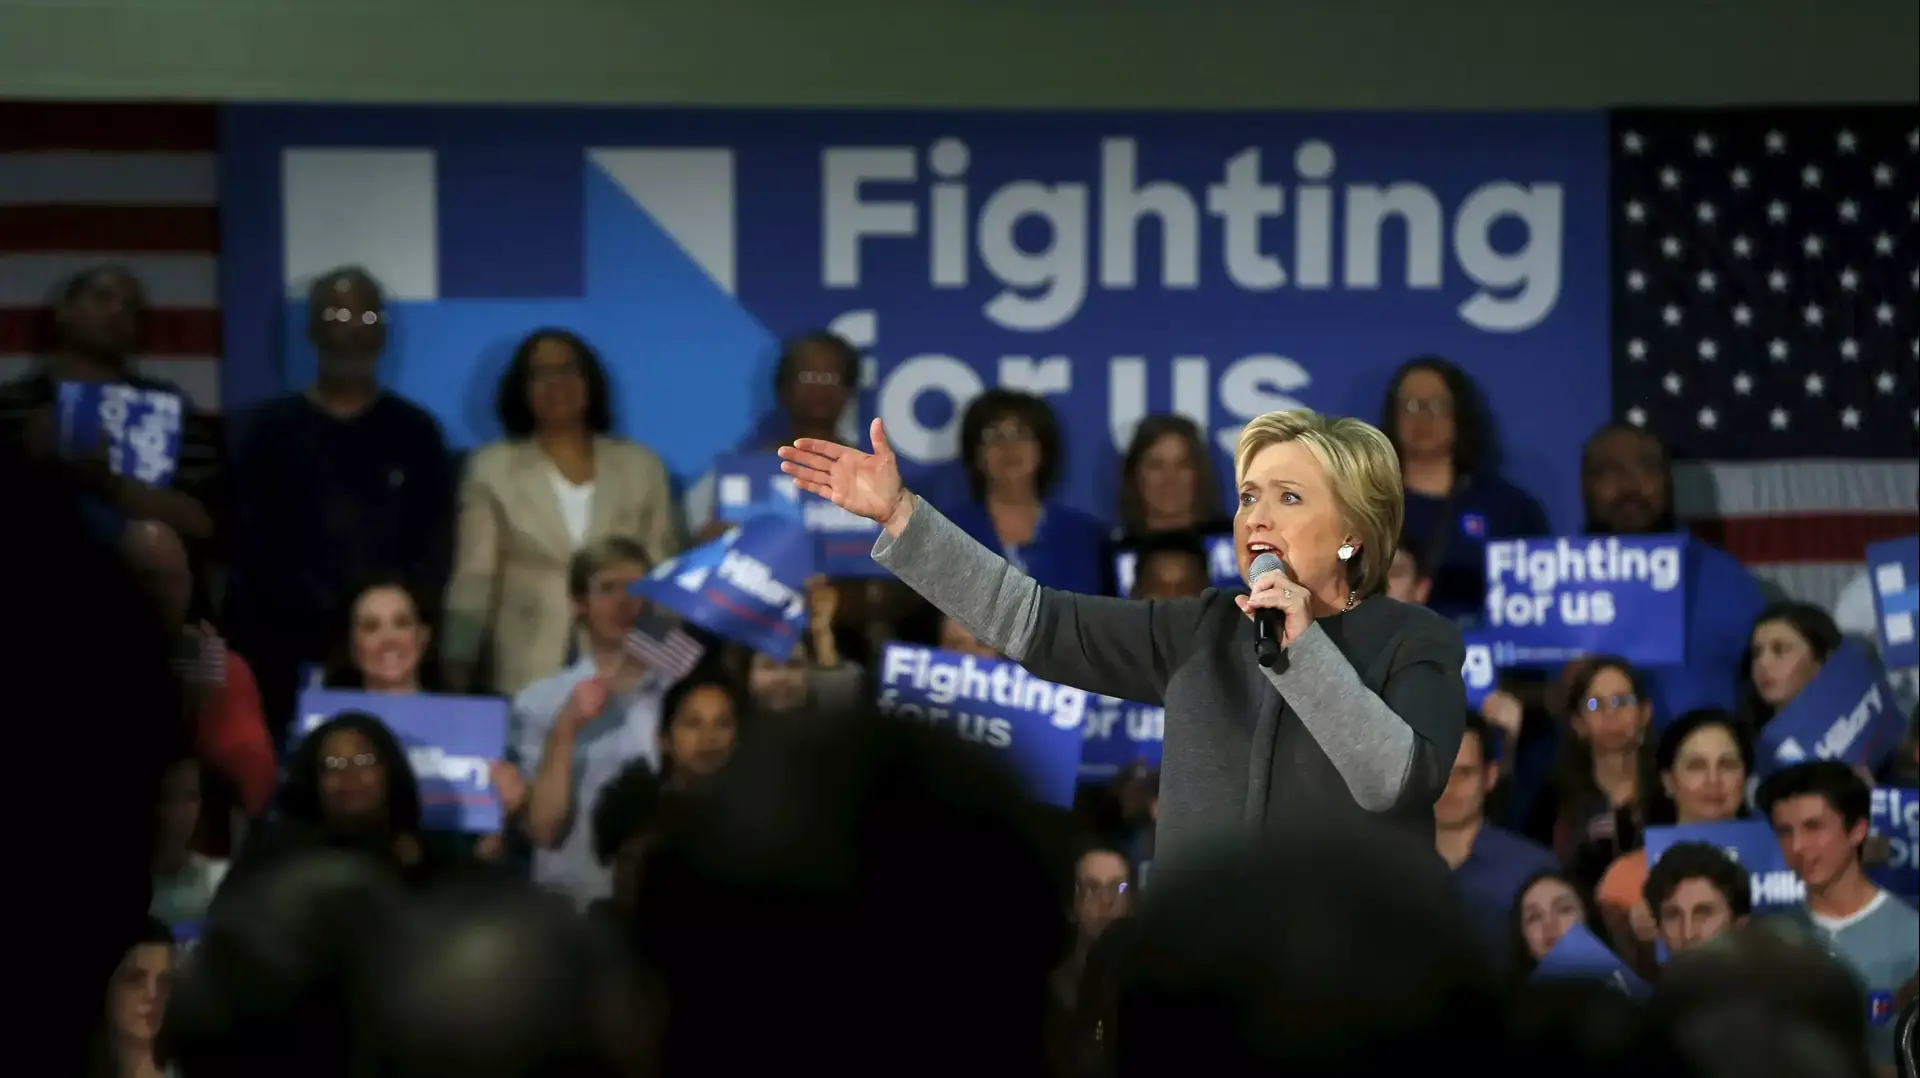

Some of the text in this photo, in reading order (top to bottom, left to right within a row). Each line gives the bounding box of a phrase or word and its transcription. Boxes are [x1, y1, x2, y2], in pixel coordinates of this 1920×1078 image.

[821, 137, 1564, 332] Fighting
[1108, 353, 1312, 462] us
[1487, 538, 1680, 591] Fighting
[1487, 583, 1616, 627] for us
[881, 644, 1088, 730] Fighting
[957, 711, 1013, 748] us
[1083, 706, 1121, 740] or
